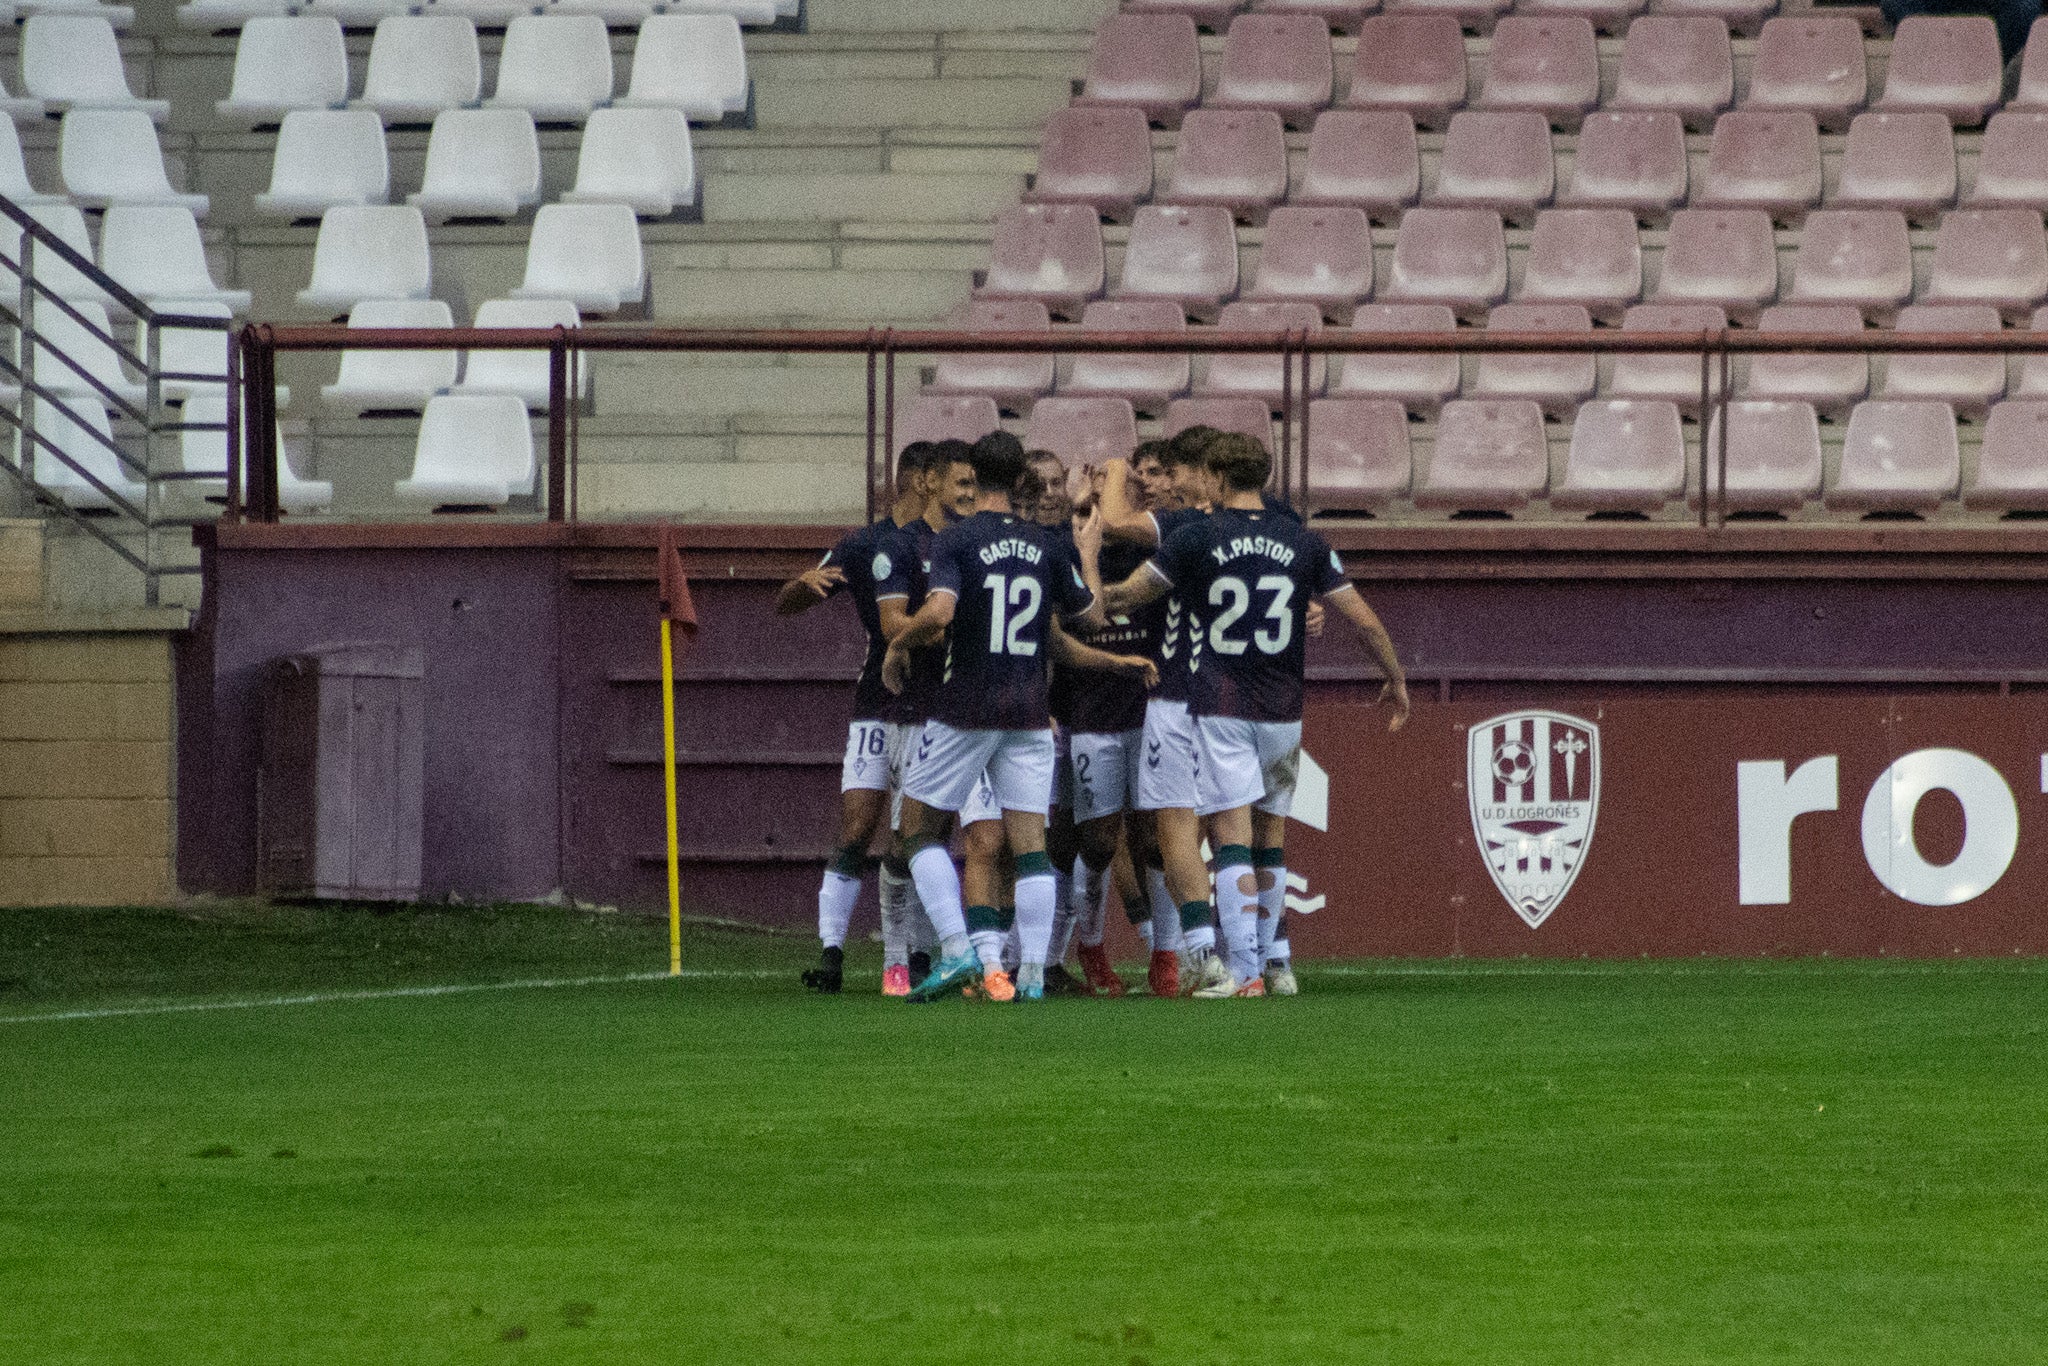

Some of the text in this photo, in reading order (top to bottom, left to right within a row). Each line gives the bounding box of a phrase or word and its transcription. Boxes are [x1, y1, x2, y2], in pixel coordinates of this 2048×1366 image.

[979, 539, 1042, 565] GASTESI
[1211, 536, 1295, 567] X.PASTOR
[983, 574, 1042, 656] 12
[1208, 575, 1295, 655] 23
[858, 727, 885, 755] 16
[1077, 753, 1092, 783] 2
[1737, 747, 2048, 907] ro
